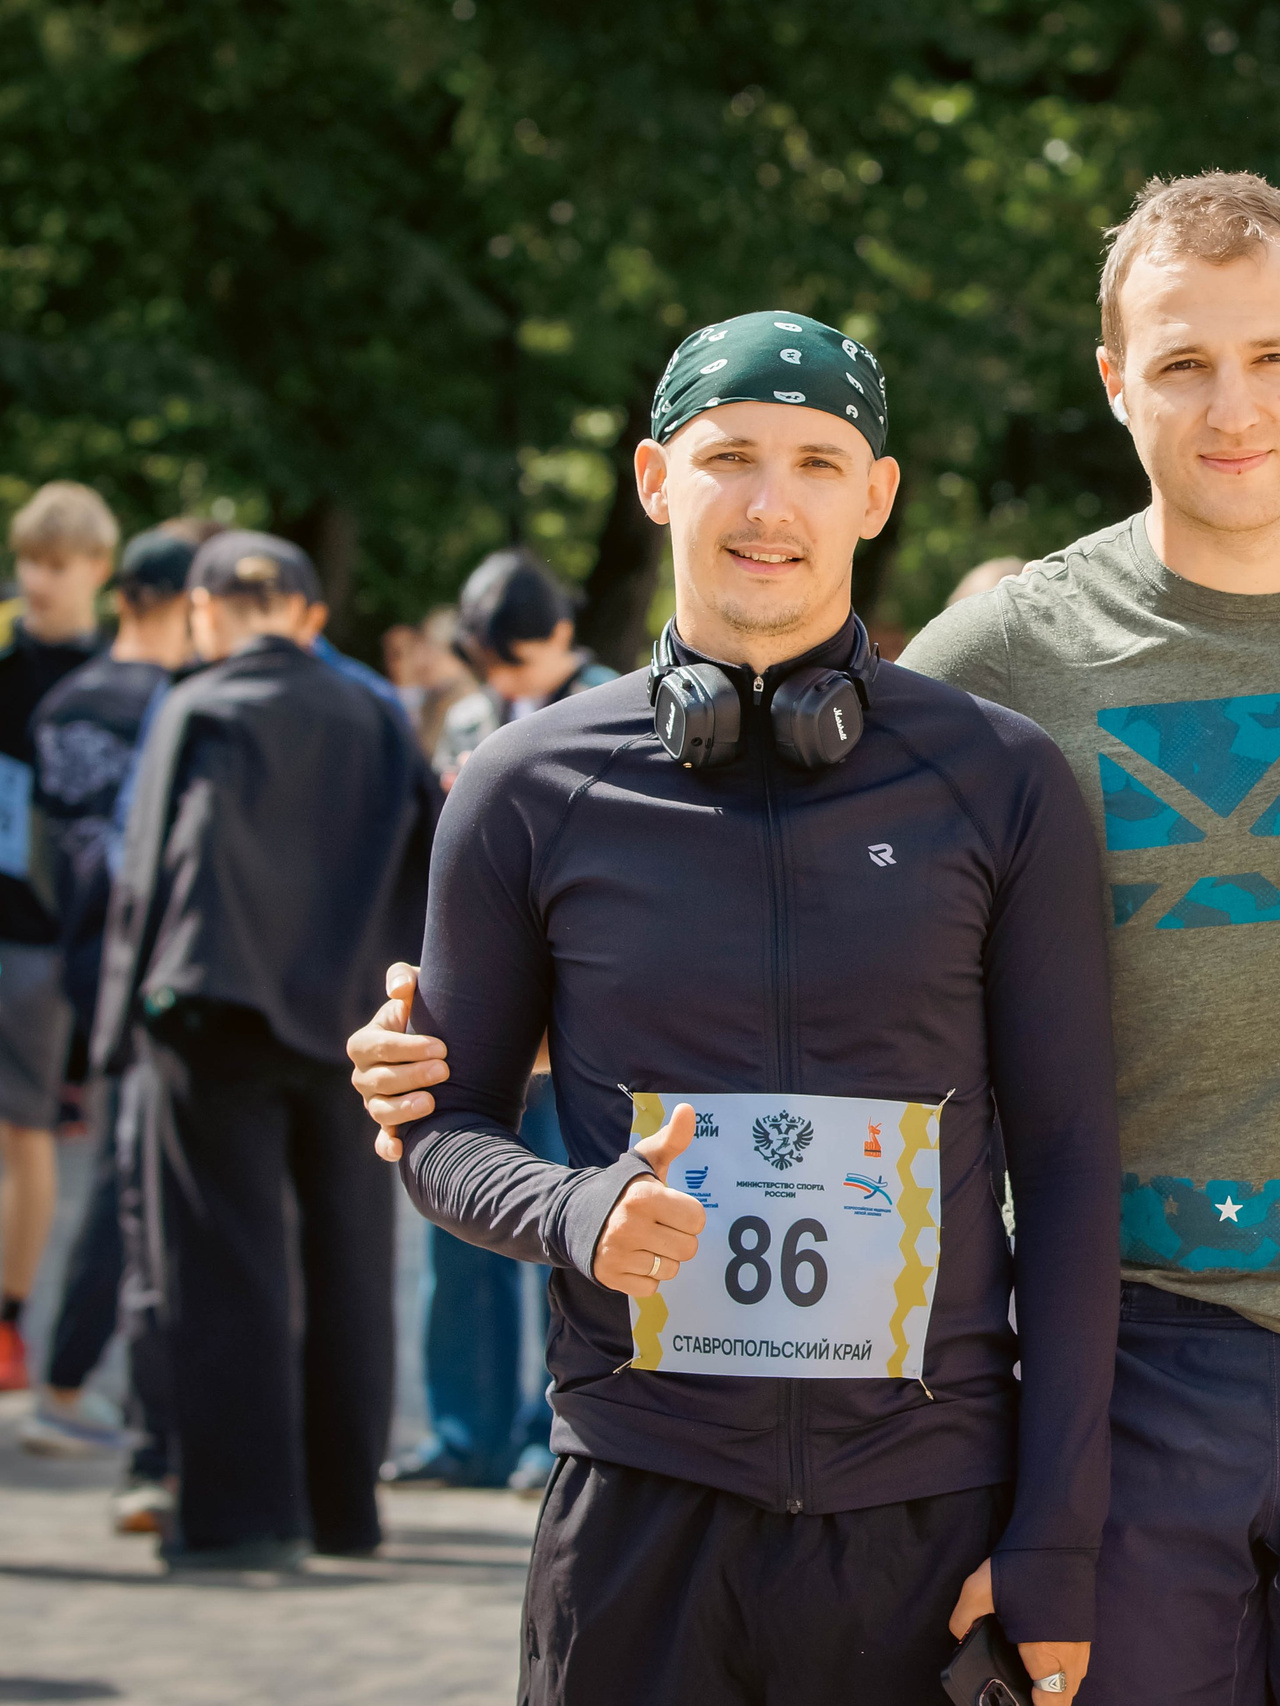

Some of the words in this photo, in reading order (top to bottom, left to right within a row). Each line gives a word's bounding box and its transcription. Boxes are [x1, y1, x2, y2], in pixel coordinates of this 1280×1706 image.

[833, 707, 847, 741] Marshall
[695, 1112, 714, 1125] ОСС
[736, 1181, 795, 1190] МИНИСТЕРСТВО
[796, 1183, 825, 1191] СПОРТА
[764, 1190, 796, 1198] РОССИИ
[724, 1215, 829, 1307] 86
[672, 1334, 830, 1360] СТАВРОПОЛЬСКИЙ
[833, 1338, 873, 1361] КРАЙ
